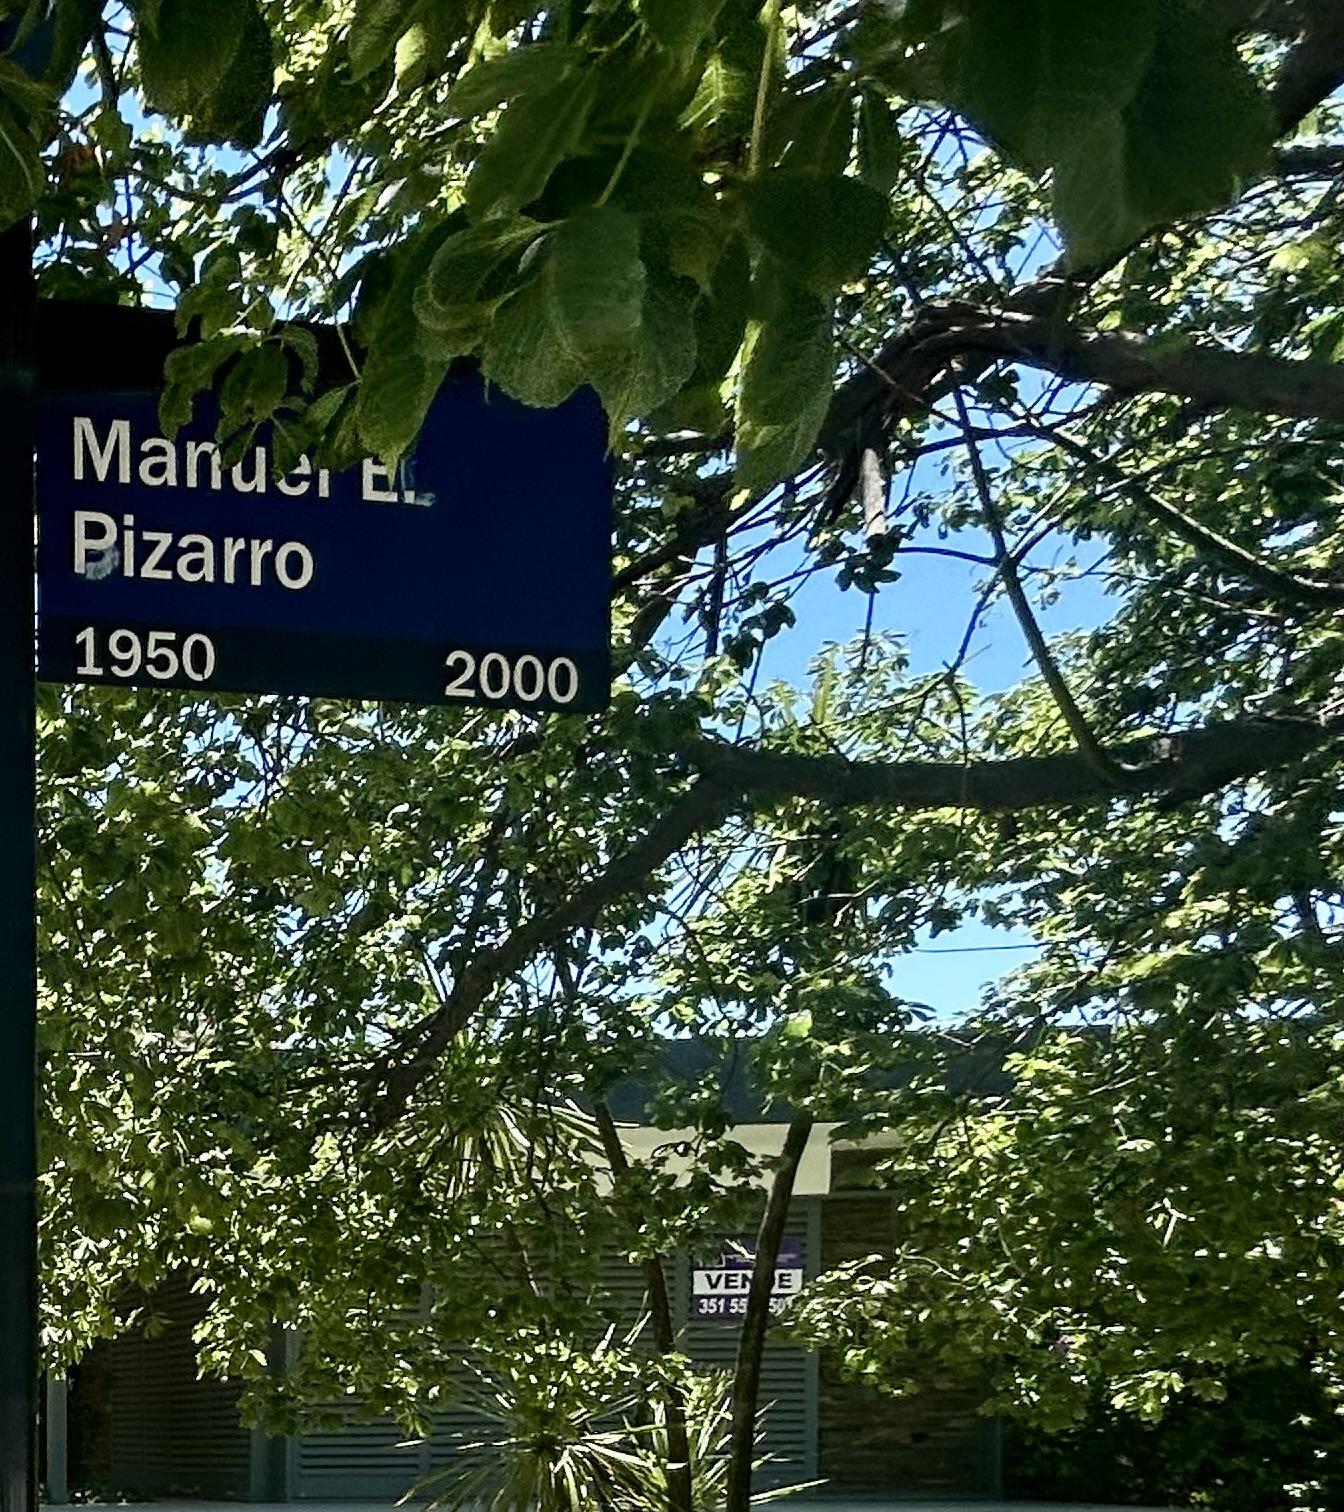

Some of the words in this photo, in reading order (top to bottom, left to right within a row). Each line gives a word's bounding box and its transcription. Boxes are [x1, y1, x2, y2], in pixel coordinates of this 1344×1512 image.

[74, 510, 314, 590] Pizarro
[75, 626, 216, 682] 1950
[444, 650, 579, 704] 2000
[705, 1273, 793, 1290] VENE
[698, 1298, 725, 1314] 351
